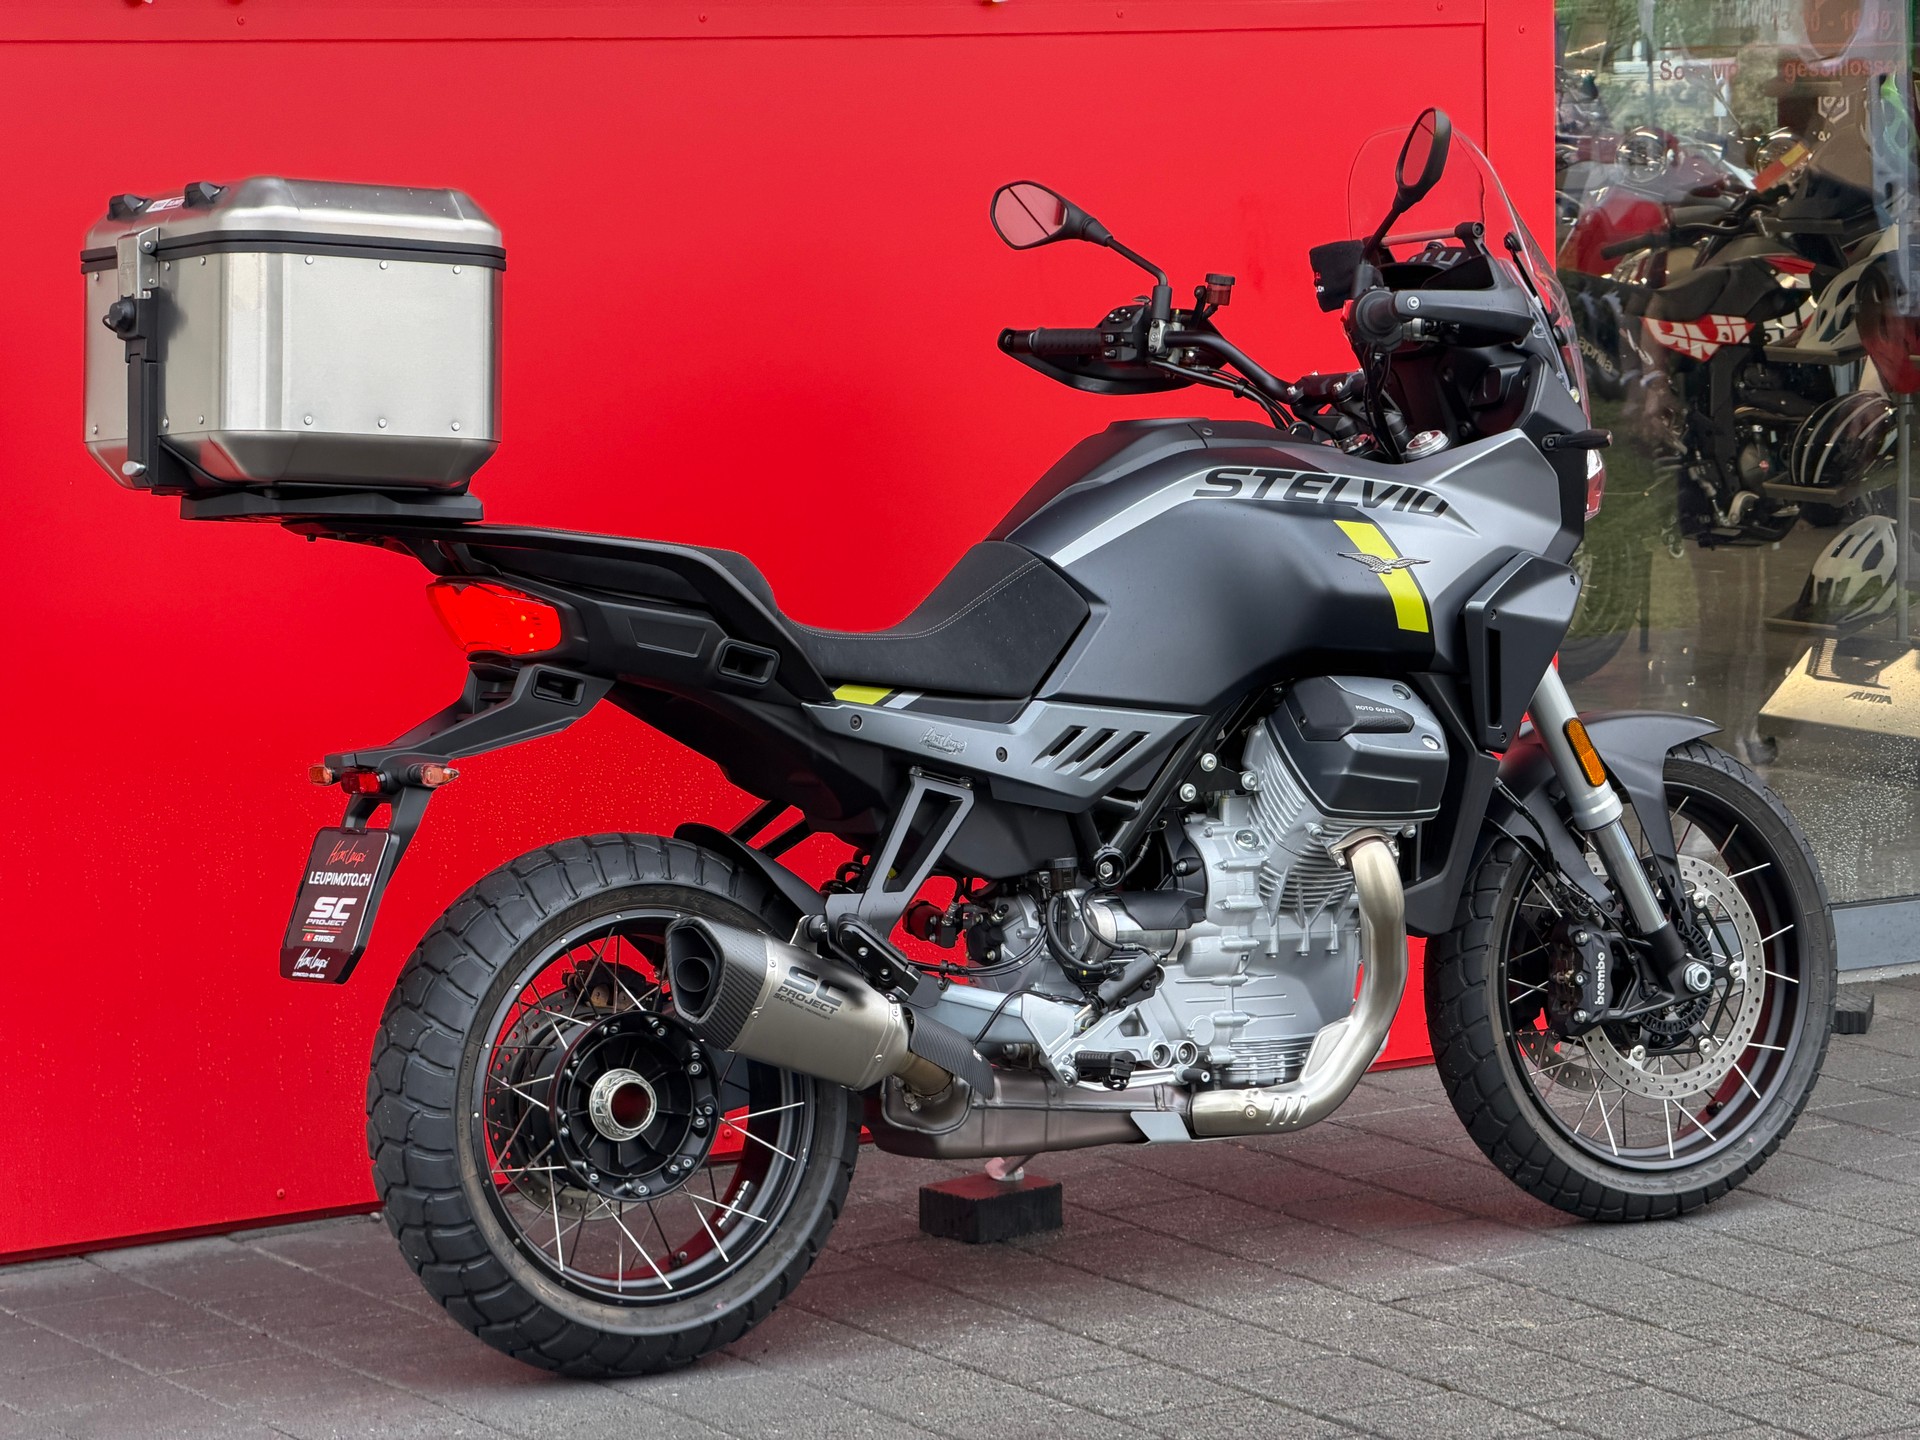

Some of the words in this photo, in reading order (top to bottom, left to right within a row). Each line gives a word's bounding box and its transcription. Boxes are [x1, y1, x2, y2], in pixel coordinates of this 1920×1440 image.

[1577, 336, 1614, 373] aprilia
[1193, 467, 1450, 518] STELVIO
[1355, 704, 1375, 712] MOTO
[1375, 706, 1396, 714] GUZZI
[1843, 691, 1893, 705] ALPINA
[308, 871, 372, 887] LEUPIMOTO.CH
[308, 896, 358, 920] SC
[305, 918, 347, 927] PROJECT
[313, 934, 336, 943] SWISS
[783, 966, 848, 1008] SC
[1594, 951, 1606, 1005] brembo
[777, 985, 839, 1015] PROJECT
